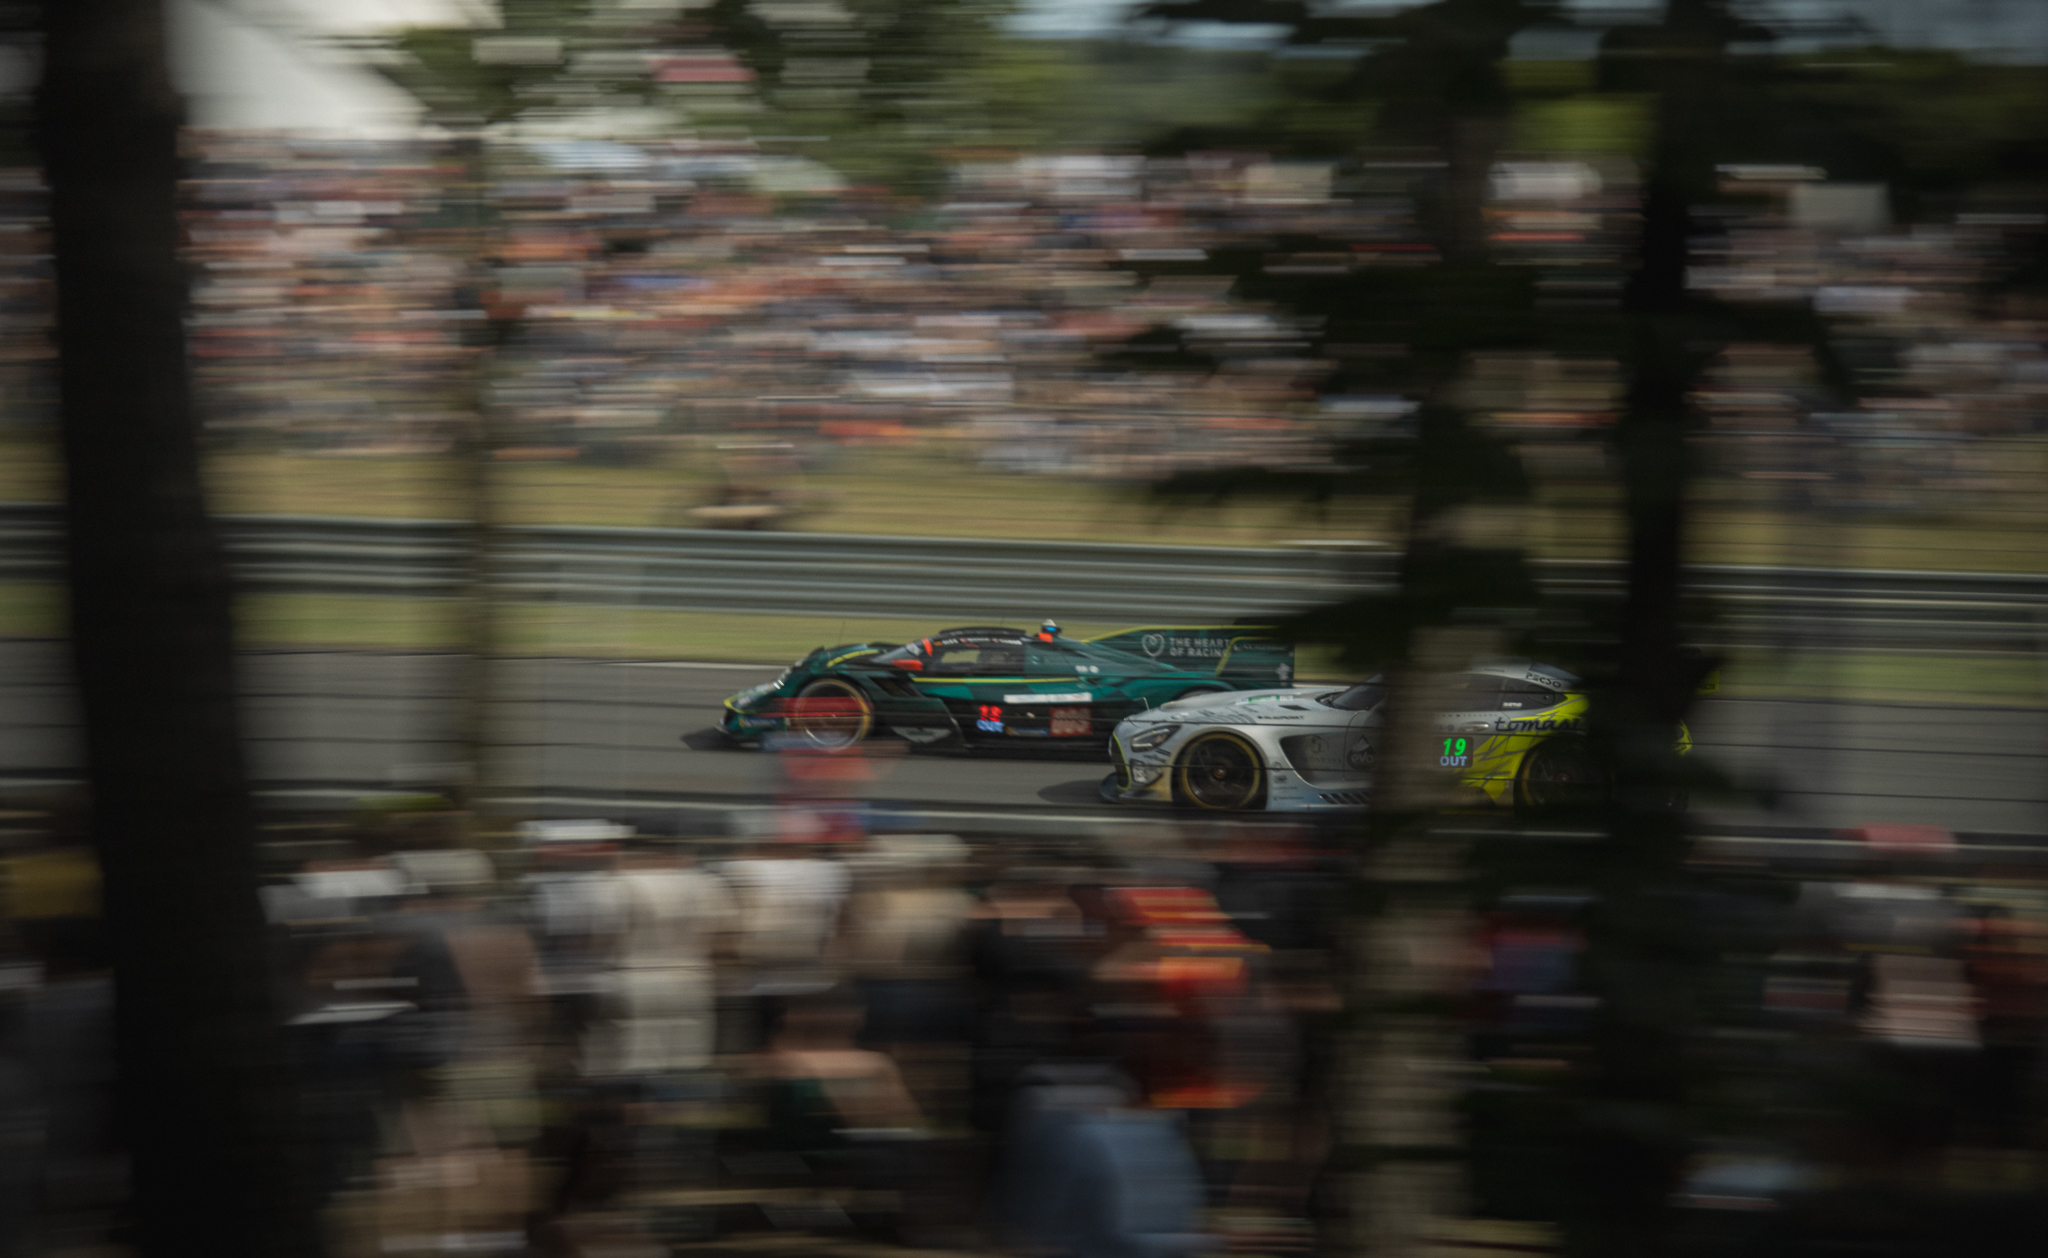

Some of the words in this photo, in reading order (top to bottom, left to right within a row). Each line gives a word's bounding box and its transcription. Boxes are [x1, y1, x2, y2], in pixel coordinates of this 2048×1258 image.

[1169, 637, 1191, 647] THE
[1194, 638, 1230, 648] HEART
[1169, 647, 1185, 657] OF
[1443, 738, 1467, 756] 19
[1351, 751, 1374, 763] evo
[1439, 755, 1468, 767] OUT
